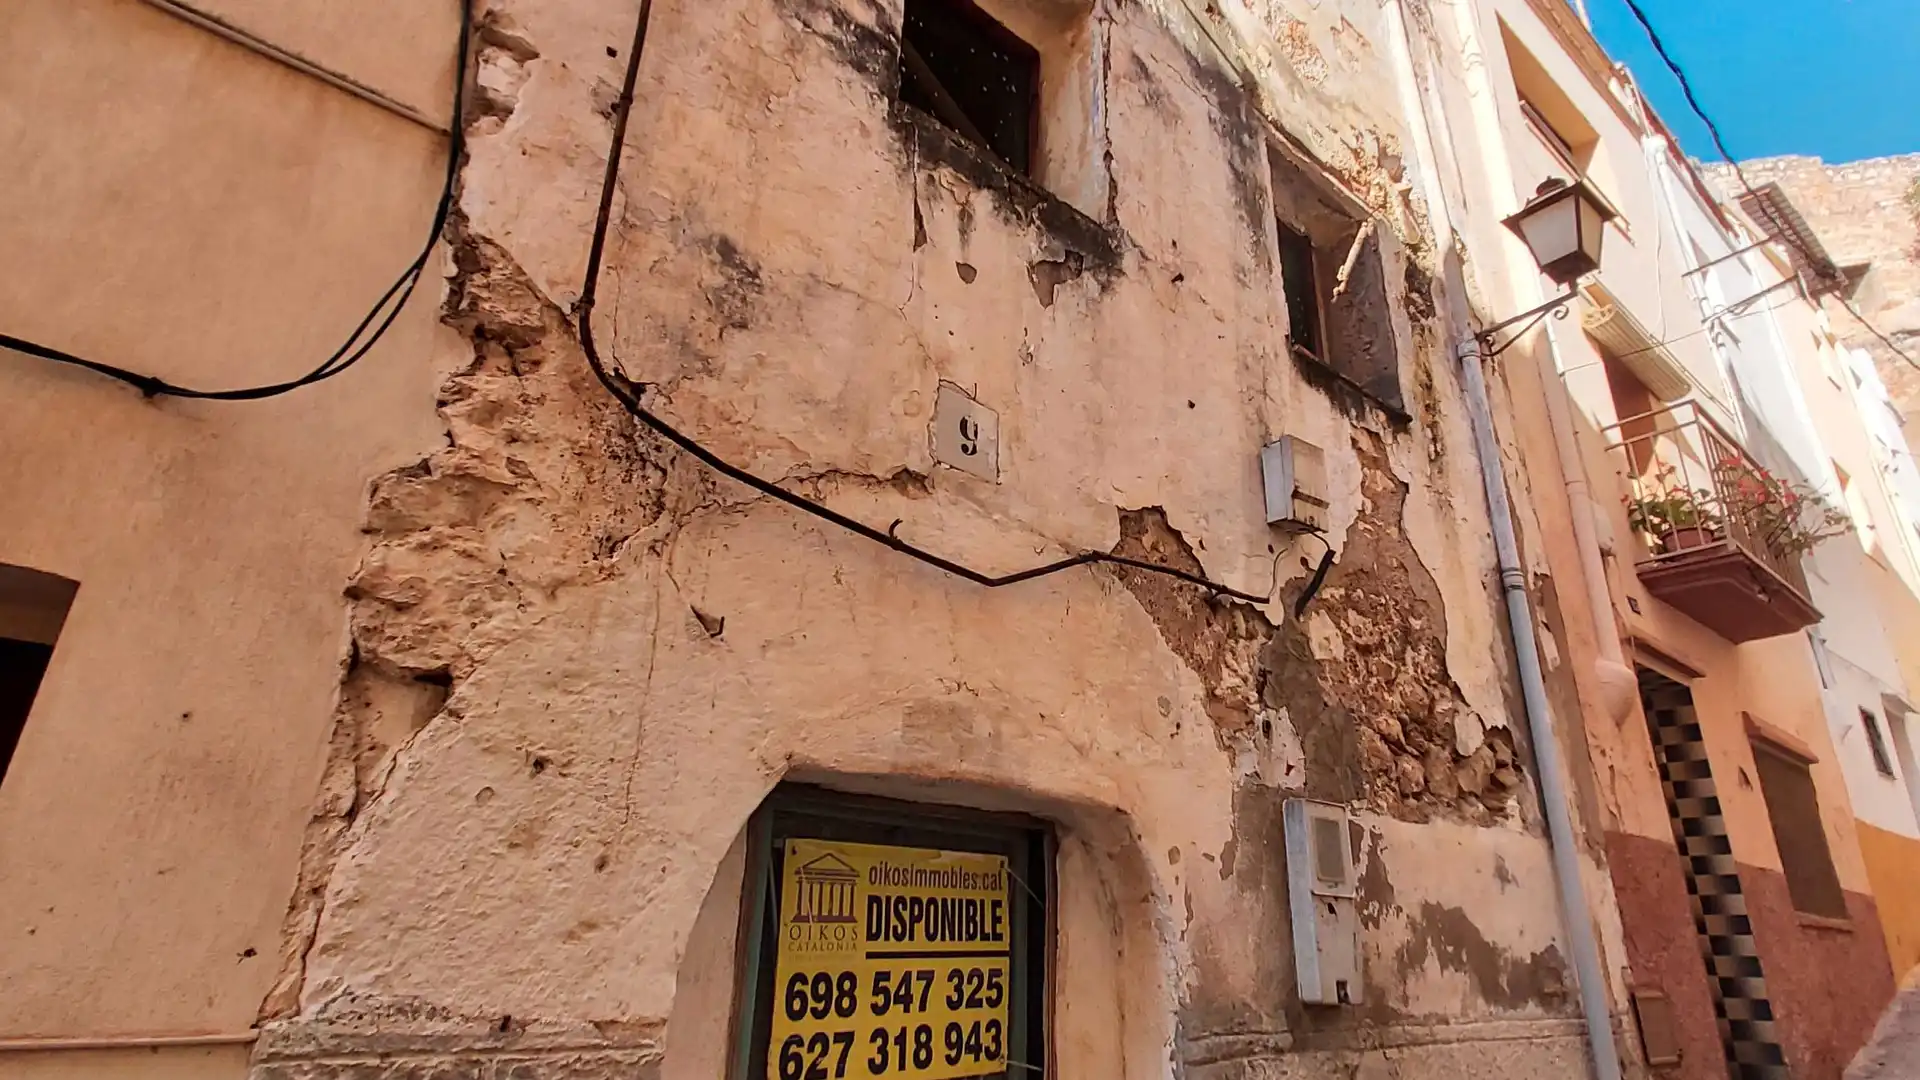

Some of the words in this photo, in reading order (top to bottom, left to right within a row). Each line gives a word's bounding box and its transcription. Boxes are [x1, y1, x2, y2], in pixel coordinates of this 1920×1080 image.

[959, 415, 979, 456] 9
[868, 860, 1003, 891] oikosimmobles.cat
[789, 924, 858, 941] OIKOS
[865, 894, 1004, 942] DISPONIBLE
[787, 941, 857, 952] CATALONIA
[785, 971, 858, 1022] 698
[870, 969, 936, 1016] 547
[945, 967, 1004, 1011] 325
[778, 1030, 855, 1080] 627
[867, 1024, 933, 1075] 318
[944, 1018, 1002, 1067] 943
